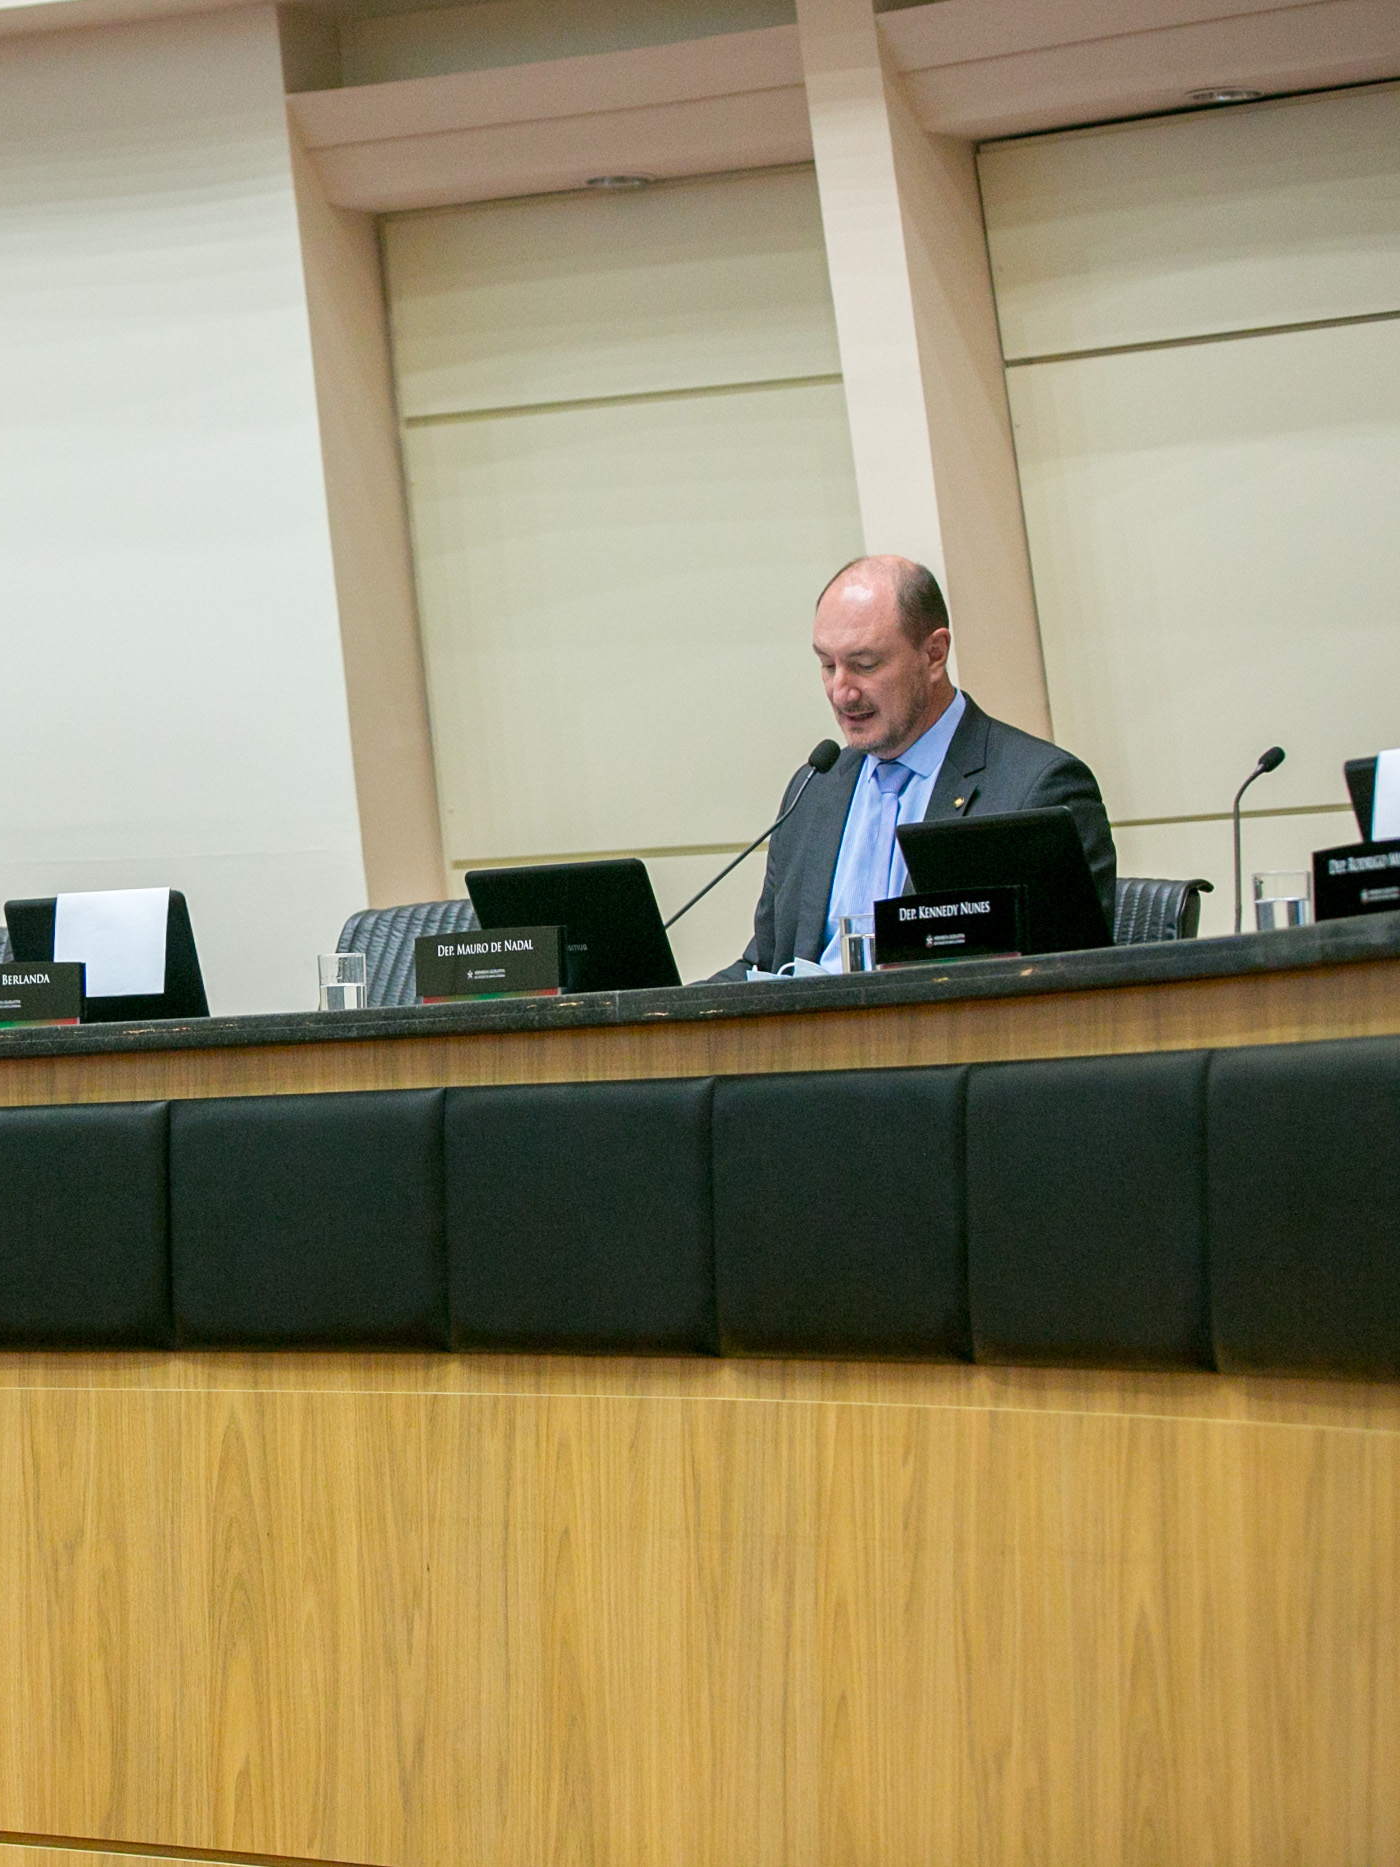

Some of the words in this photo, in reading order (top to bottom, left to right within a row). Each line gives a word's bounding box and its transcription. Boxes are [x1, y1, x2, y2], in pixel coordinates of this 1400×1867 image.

[918, 904, 959, 919] KENNEDY
[960, 901, 991, 915] NUNES
[456, 943, 489, 955] MAURO
[490, 941, 502, 953] DE
[504, 939, 534, 951] NADAL
[2, 973, 50, 986] BERLANDA
